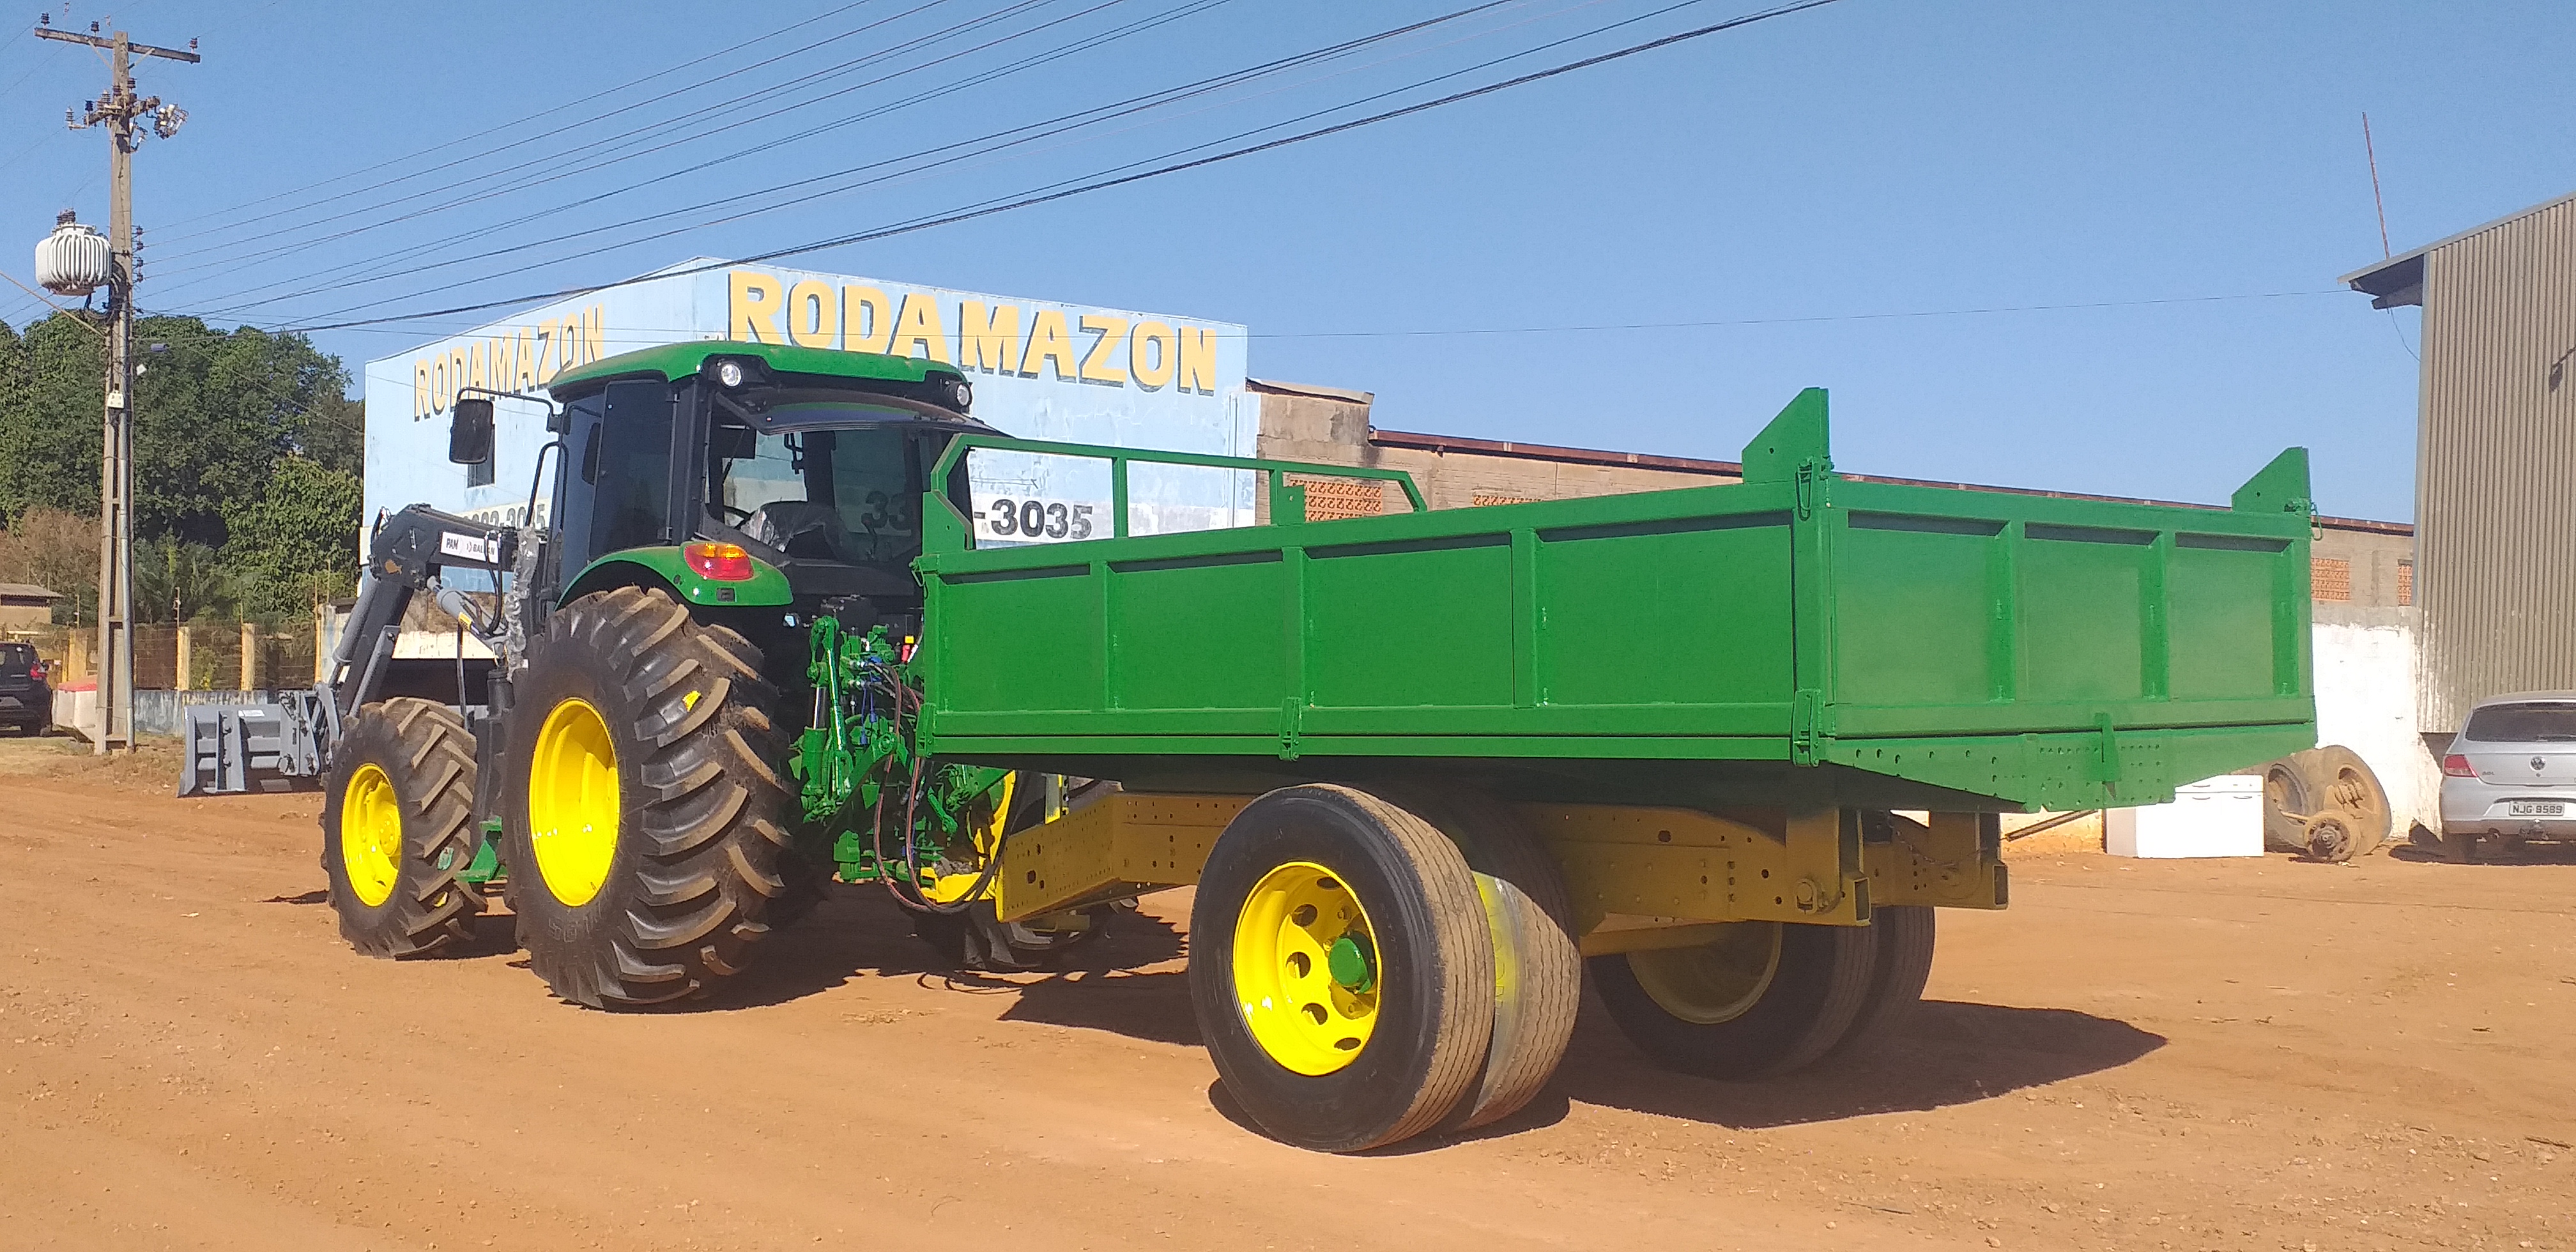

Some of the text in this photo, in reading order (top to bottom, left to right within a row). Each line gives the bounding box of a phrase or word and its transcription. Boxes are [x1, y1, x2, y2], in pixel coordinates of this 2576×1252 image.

[414, 303, 604, 422] RODAMAZON
[728, 270, 1217, 397] RODAMAZON
[2513, 805, 2533, 813] NJG
